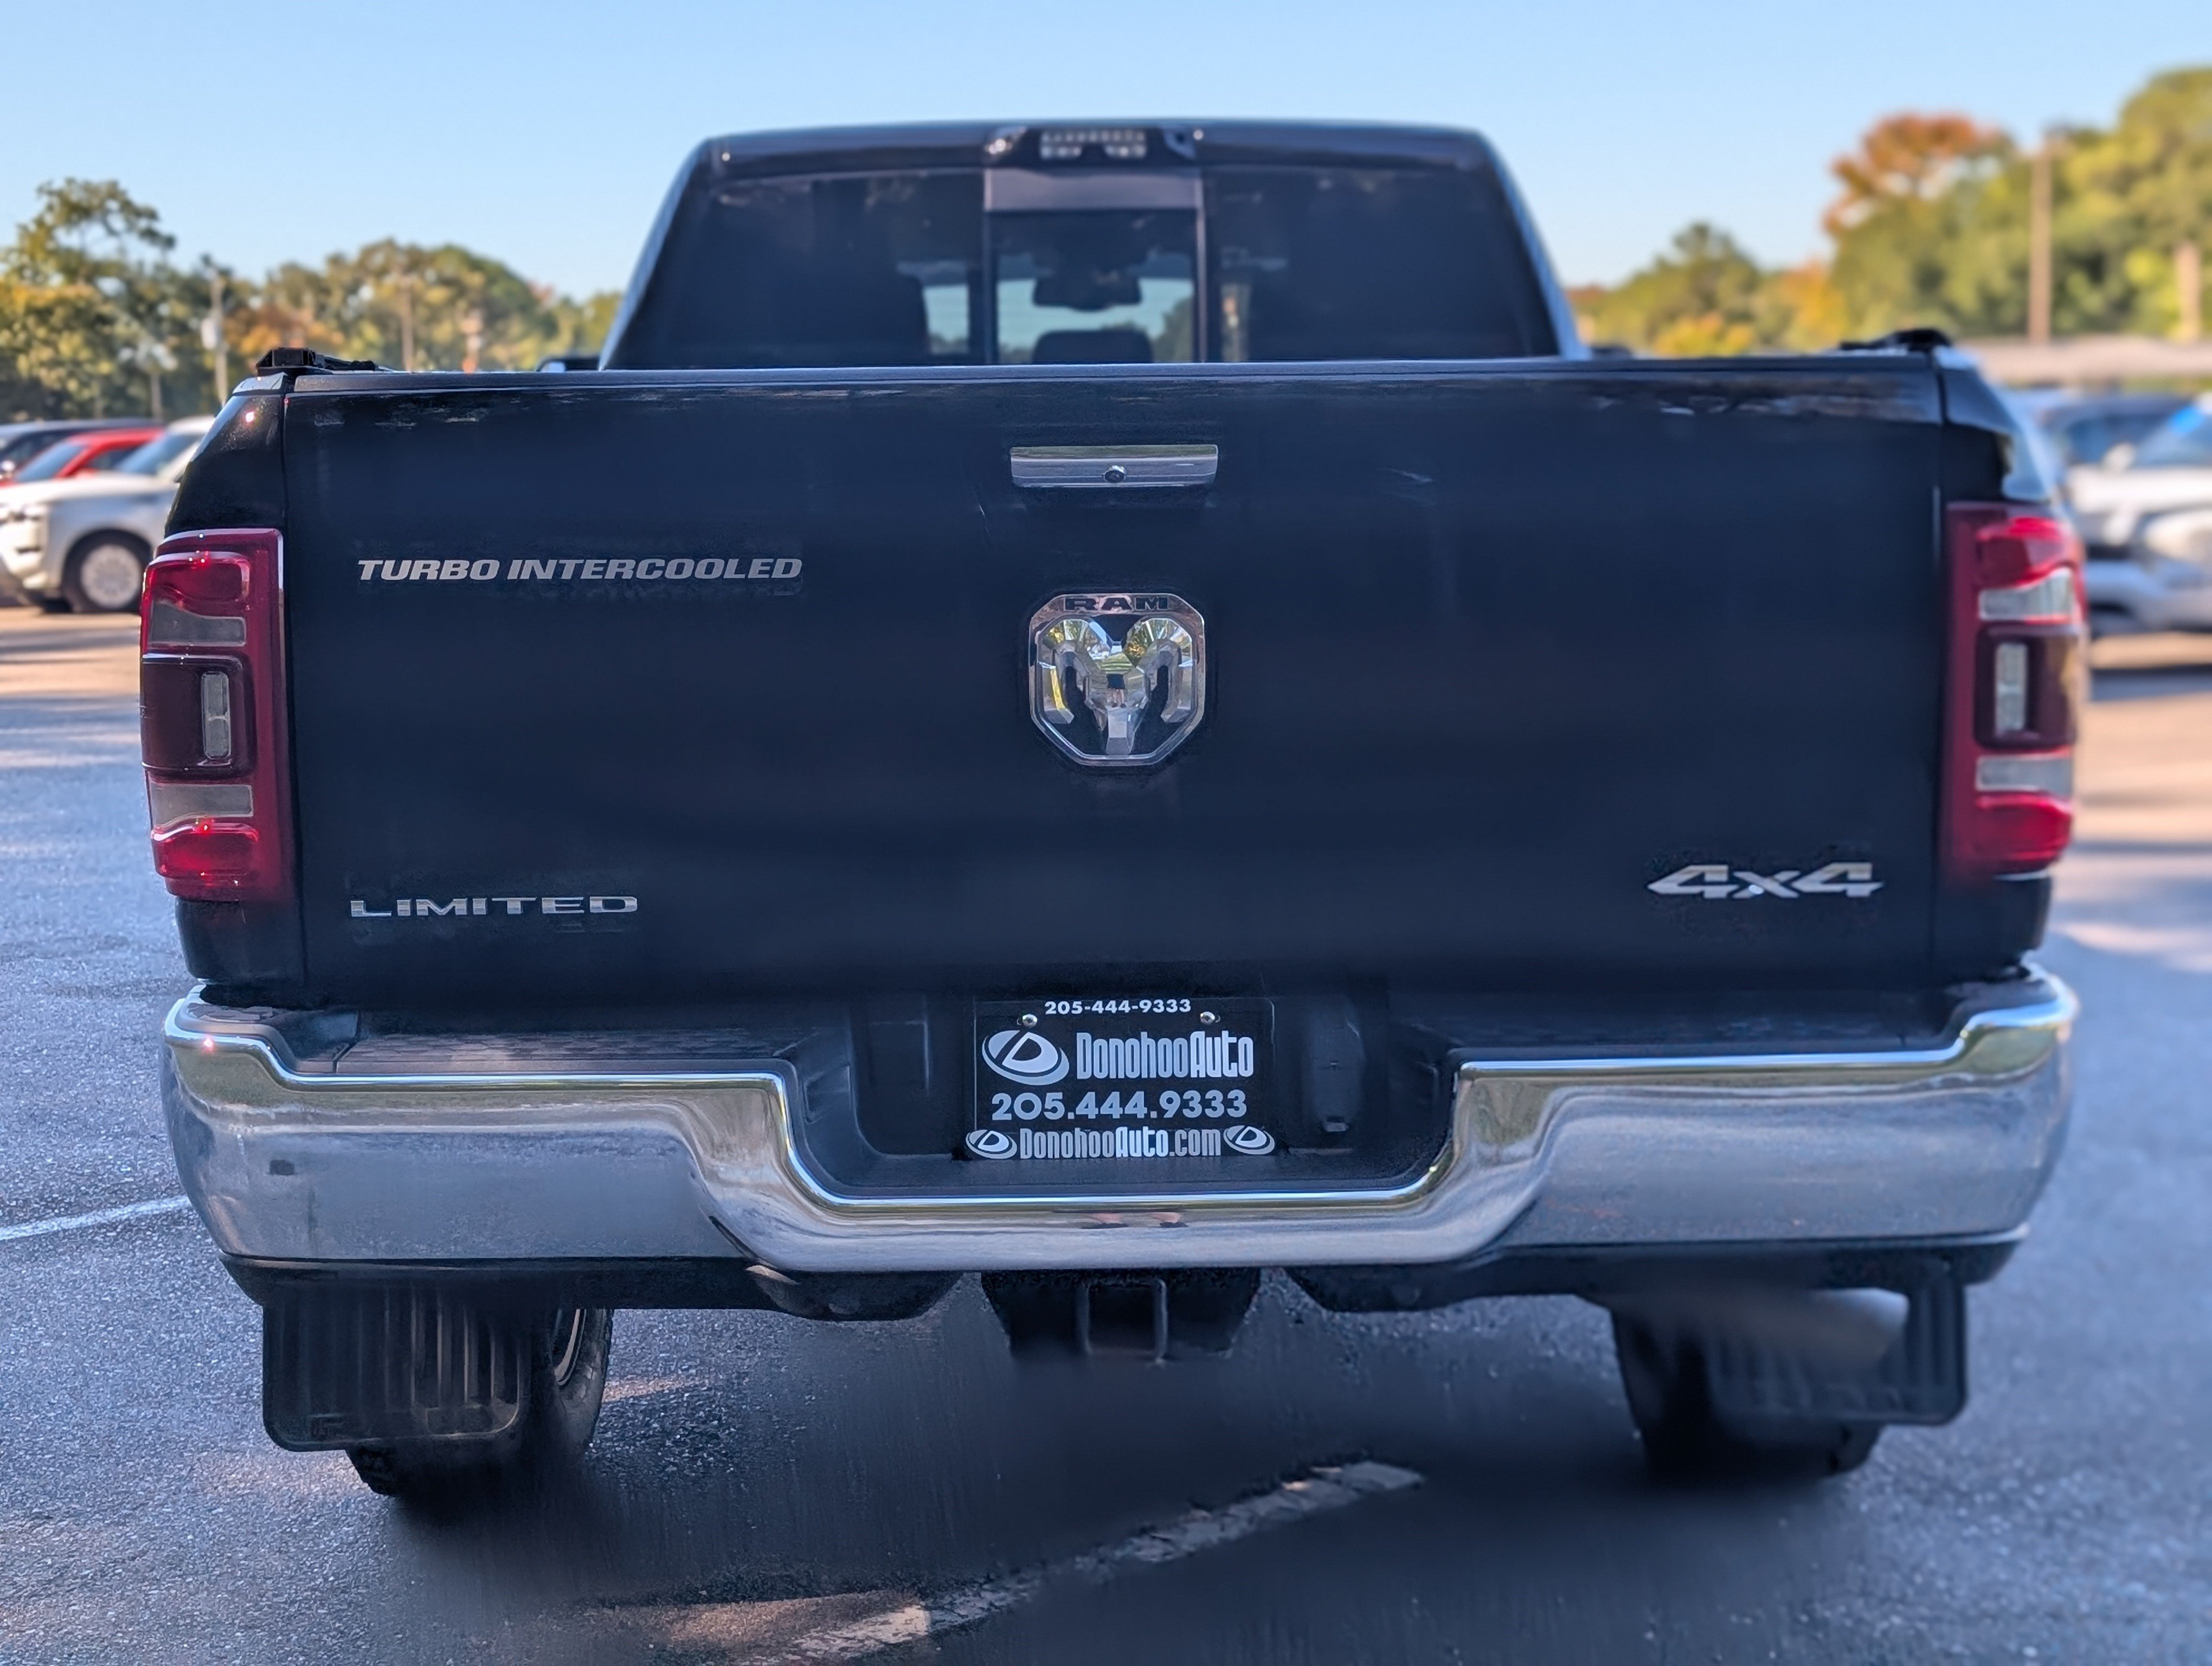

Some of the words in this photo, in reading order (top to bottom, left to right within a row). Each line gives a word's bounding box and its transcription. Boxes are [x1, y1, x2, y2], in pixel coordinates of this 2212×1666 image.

[358, 559, 500, 581] TURBO
[507, 558, 803, 580] INTERCOOLED
[1065, 597, 1168, 611] RAM
[1647, 862, 1884, 899] 4x4
[350, 896, 638, 917] LIMITED
[1045, 998, 1191, 1015] 205-444-9333
[1076, 1030, 1253, 1079] DonohooAuto
[991, 1090, 1247, 1120] 205.444.9333
[1019, 1126, 1221, 1158] DonohooAuto.com
